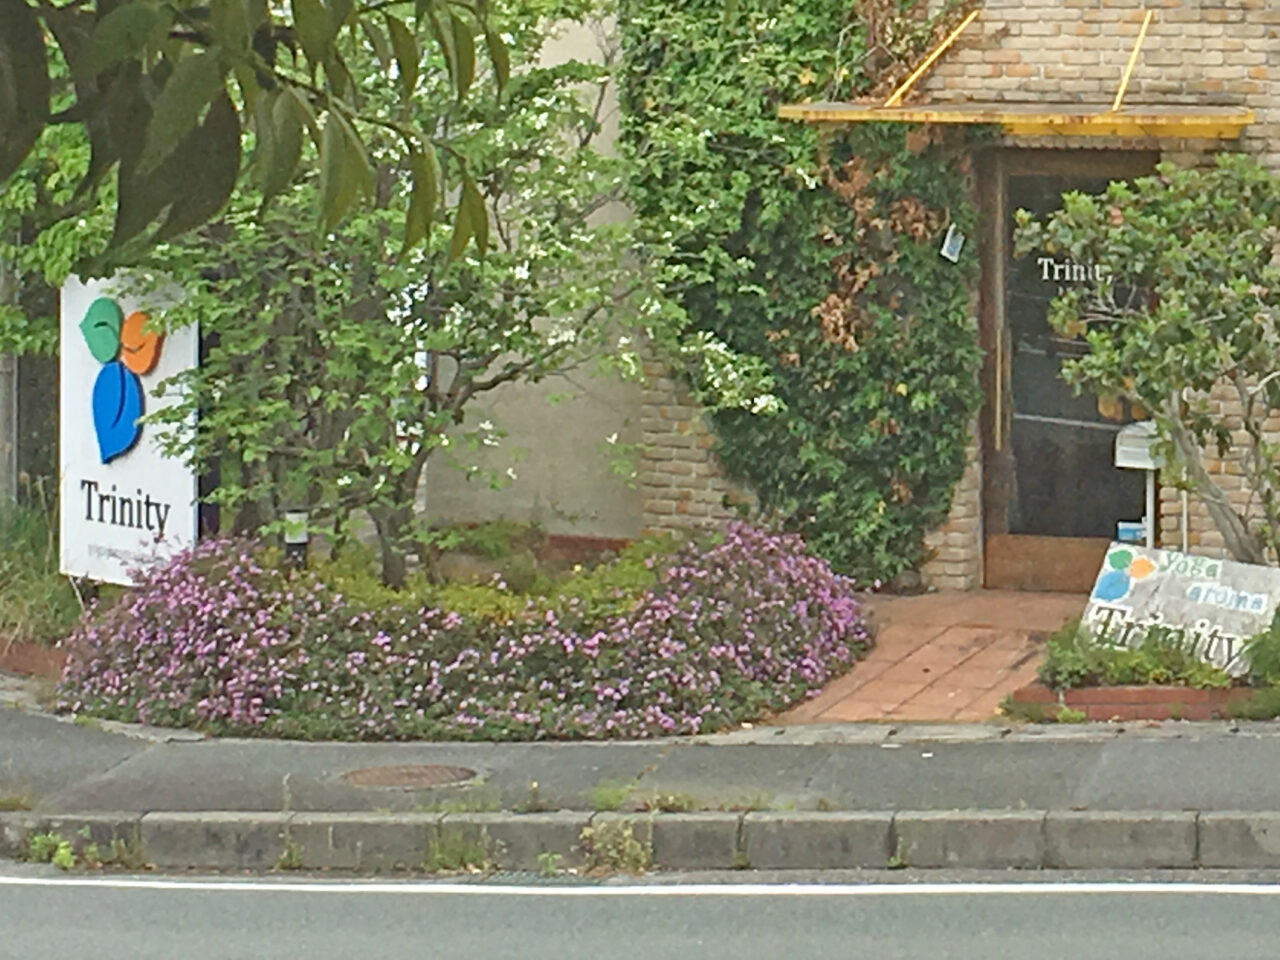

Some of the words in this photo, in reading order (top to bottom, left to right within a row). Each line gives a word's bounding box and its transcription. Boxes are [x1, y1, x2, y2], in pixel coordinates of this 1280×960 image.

[80, 479, 171, 543] Trinity
[1157, 552, 1220, 578] yoga
[1186, 585, 1265, 611] aroma
[1095, 606, 1246, 670] Trity
